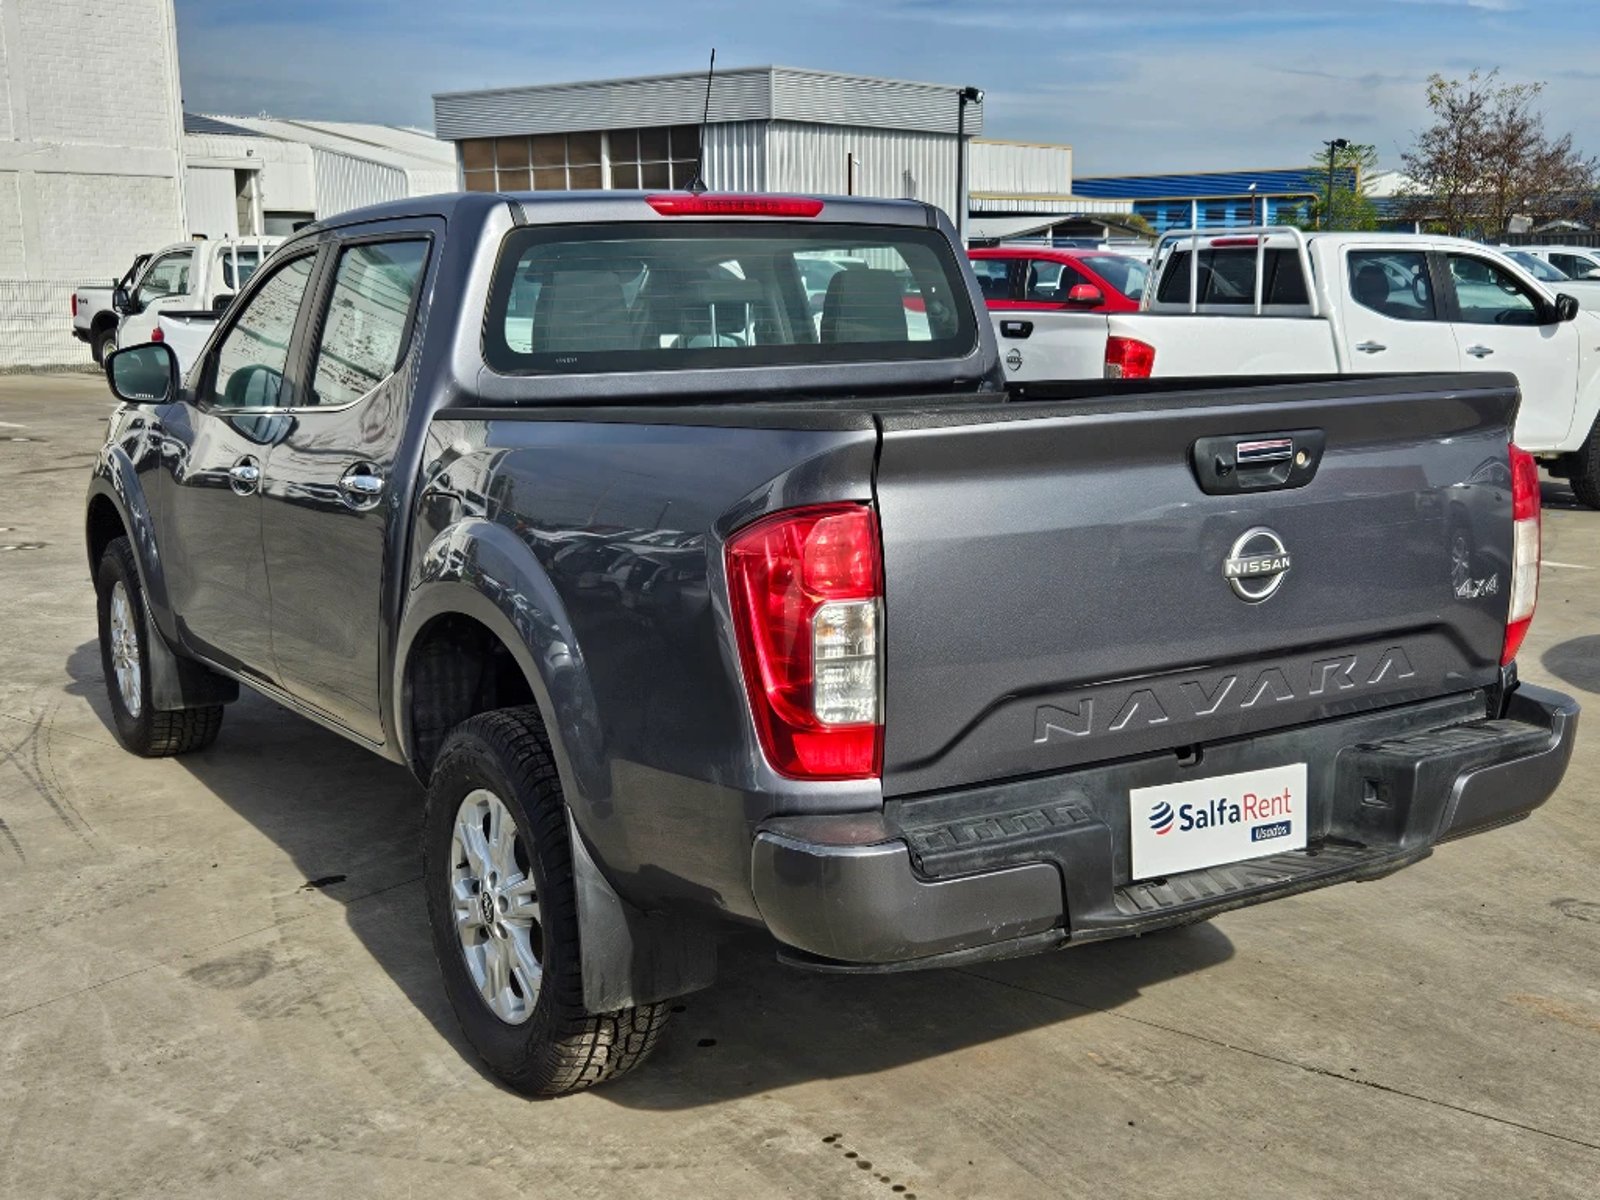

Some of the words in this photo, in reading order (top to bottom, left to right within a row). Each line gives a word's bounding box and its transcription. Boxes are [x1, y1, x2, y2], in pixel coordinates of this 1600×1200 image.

[1228, 556, 1290, 575] NISSAN
[1033, 646, 1415, 743] NAVARA
[1179, 787, 1292, 832] SalfaRent
[1255, 824, 1288, 840] Usados
